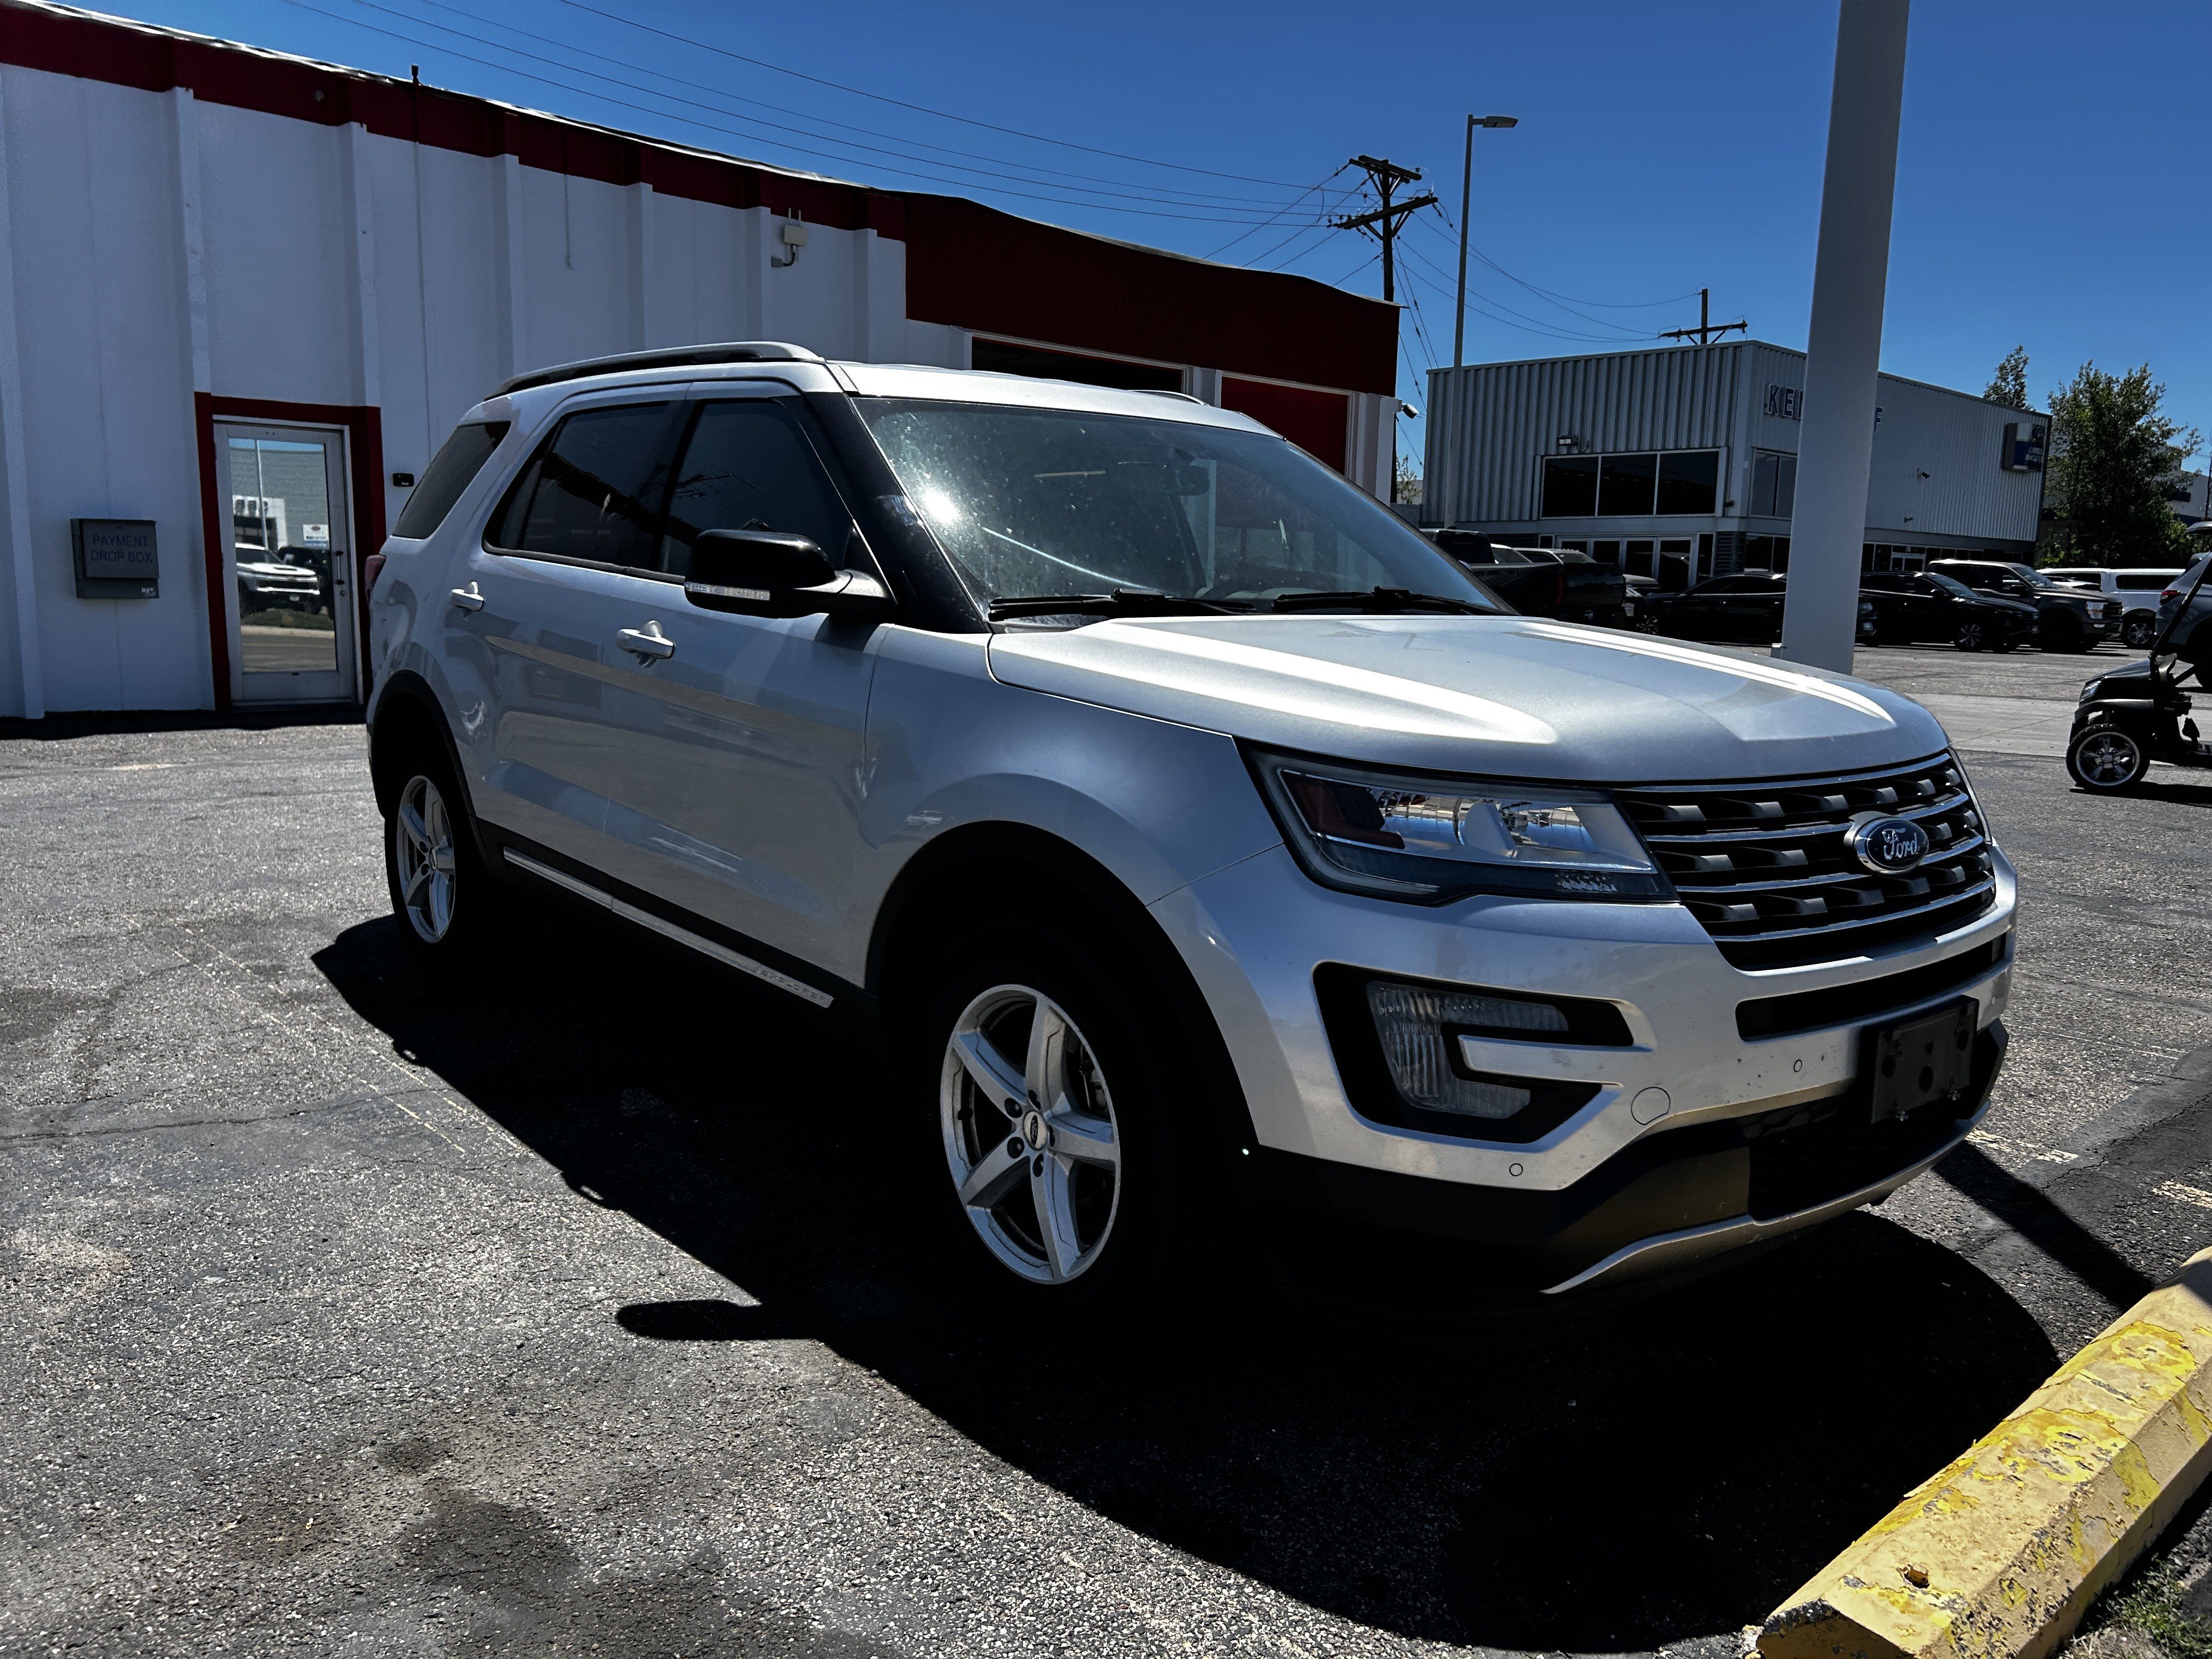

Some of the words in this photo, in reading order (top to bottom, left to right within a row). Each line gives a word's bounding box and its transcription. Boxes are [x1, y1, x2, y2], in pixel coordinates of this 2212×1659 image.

[92, 534, 149, 547] PAYMENT
[91, 549, 125, 562] DROP
[128, 551, 153, 563] BOX
[1881, 827, 1920, 861] Ford
